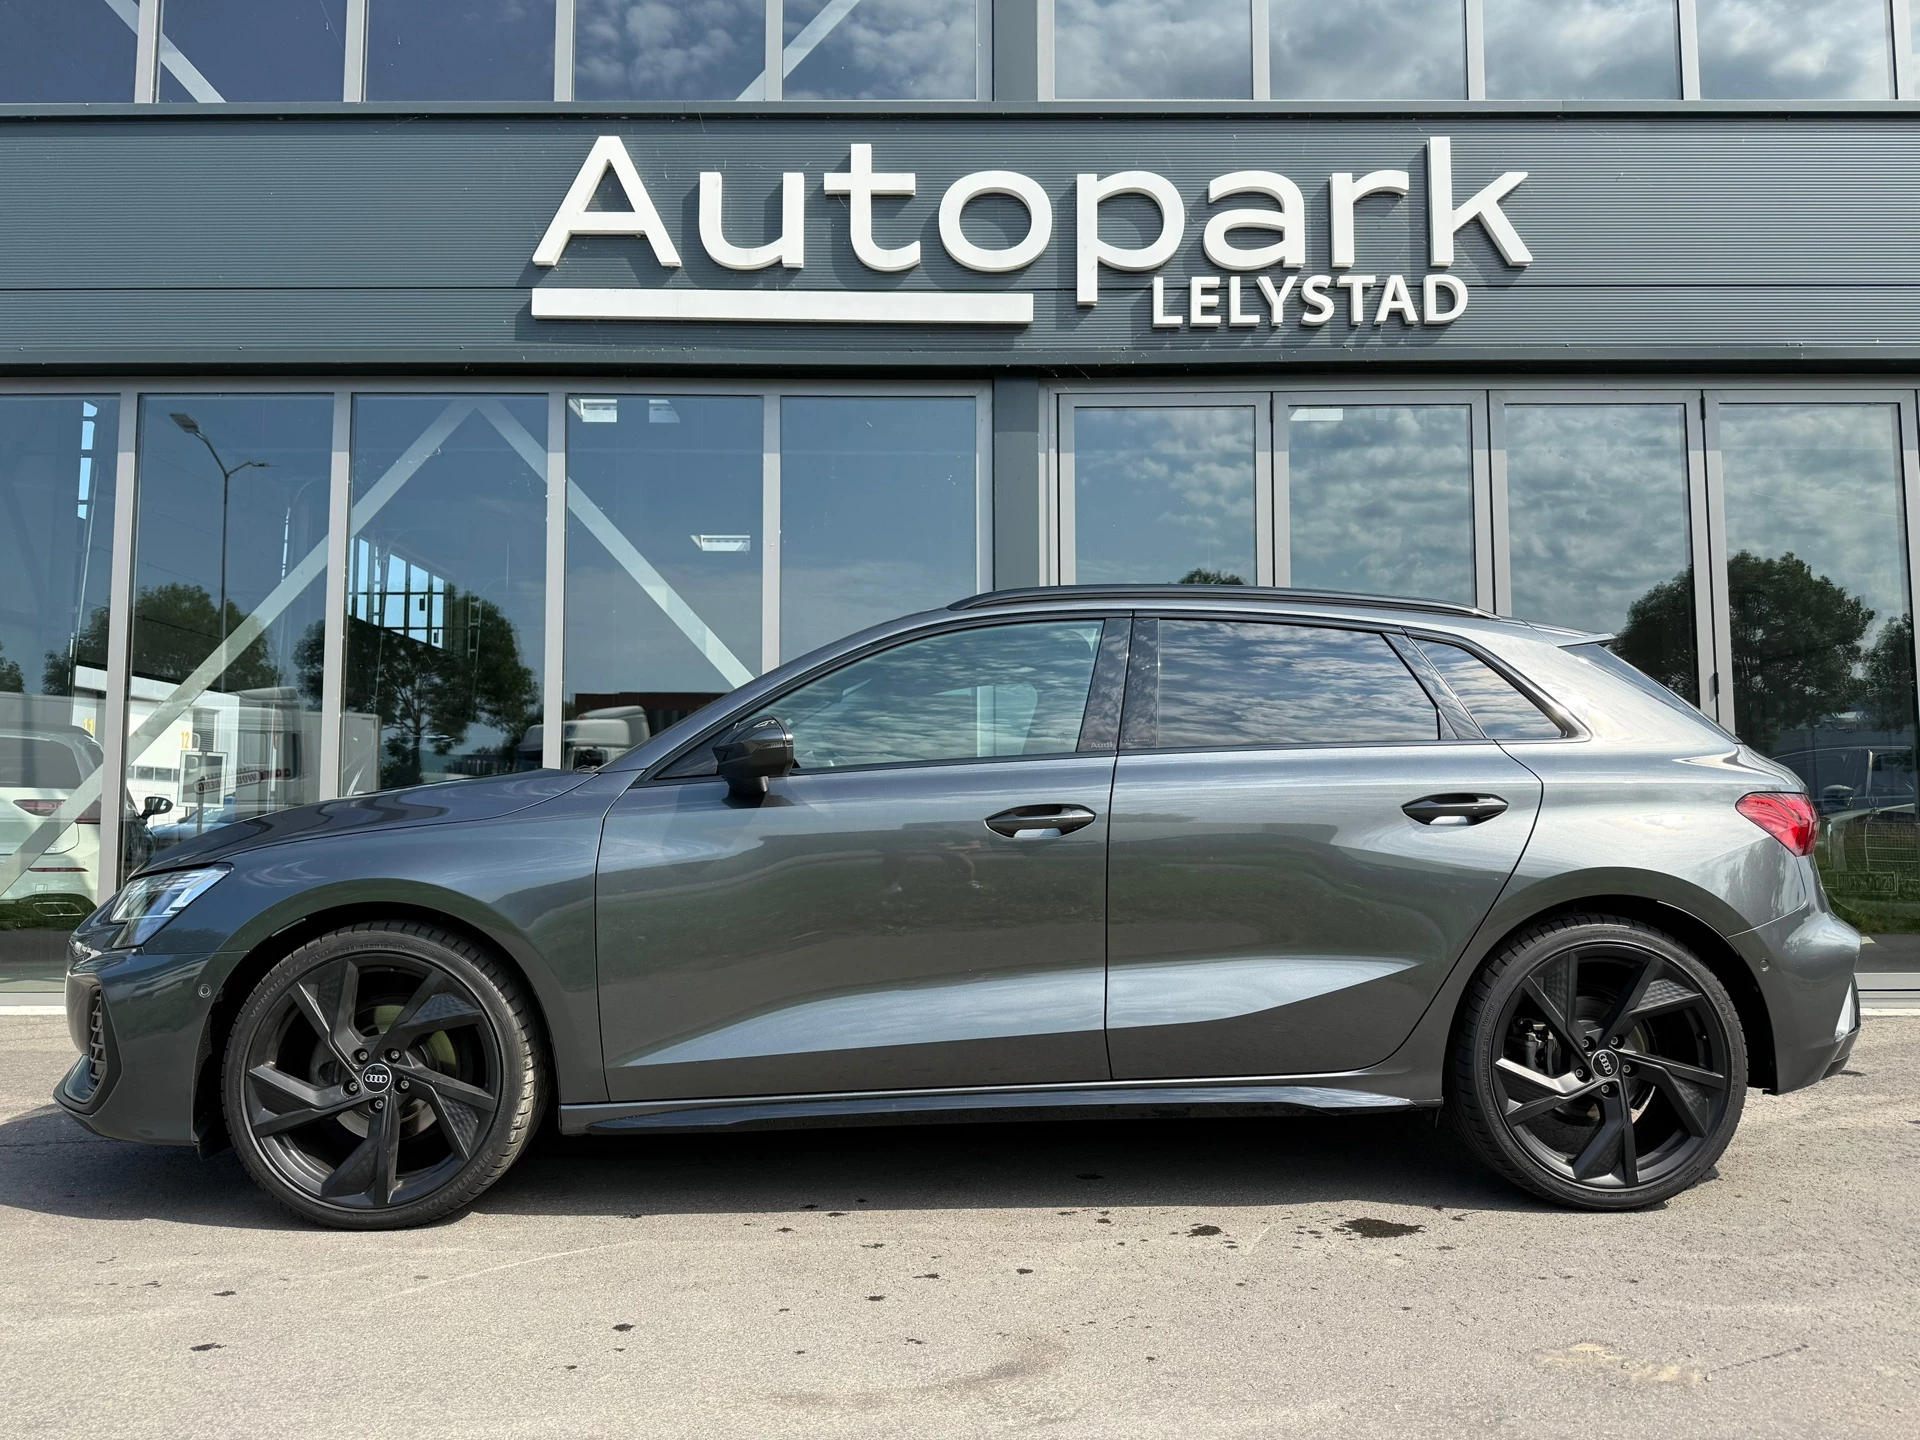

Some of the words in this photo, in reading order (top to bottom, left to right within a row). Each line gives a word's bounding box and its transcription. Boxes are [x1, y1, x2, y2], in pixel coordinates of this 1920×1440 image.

[532, 136, 1533, 307] Autopark
[1152, 274, 1468, 328] LELYSTAD
[181, 731, 190, 749] 12
[1090, 742, 1113, 750] Audi
